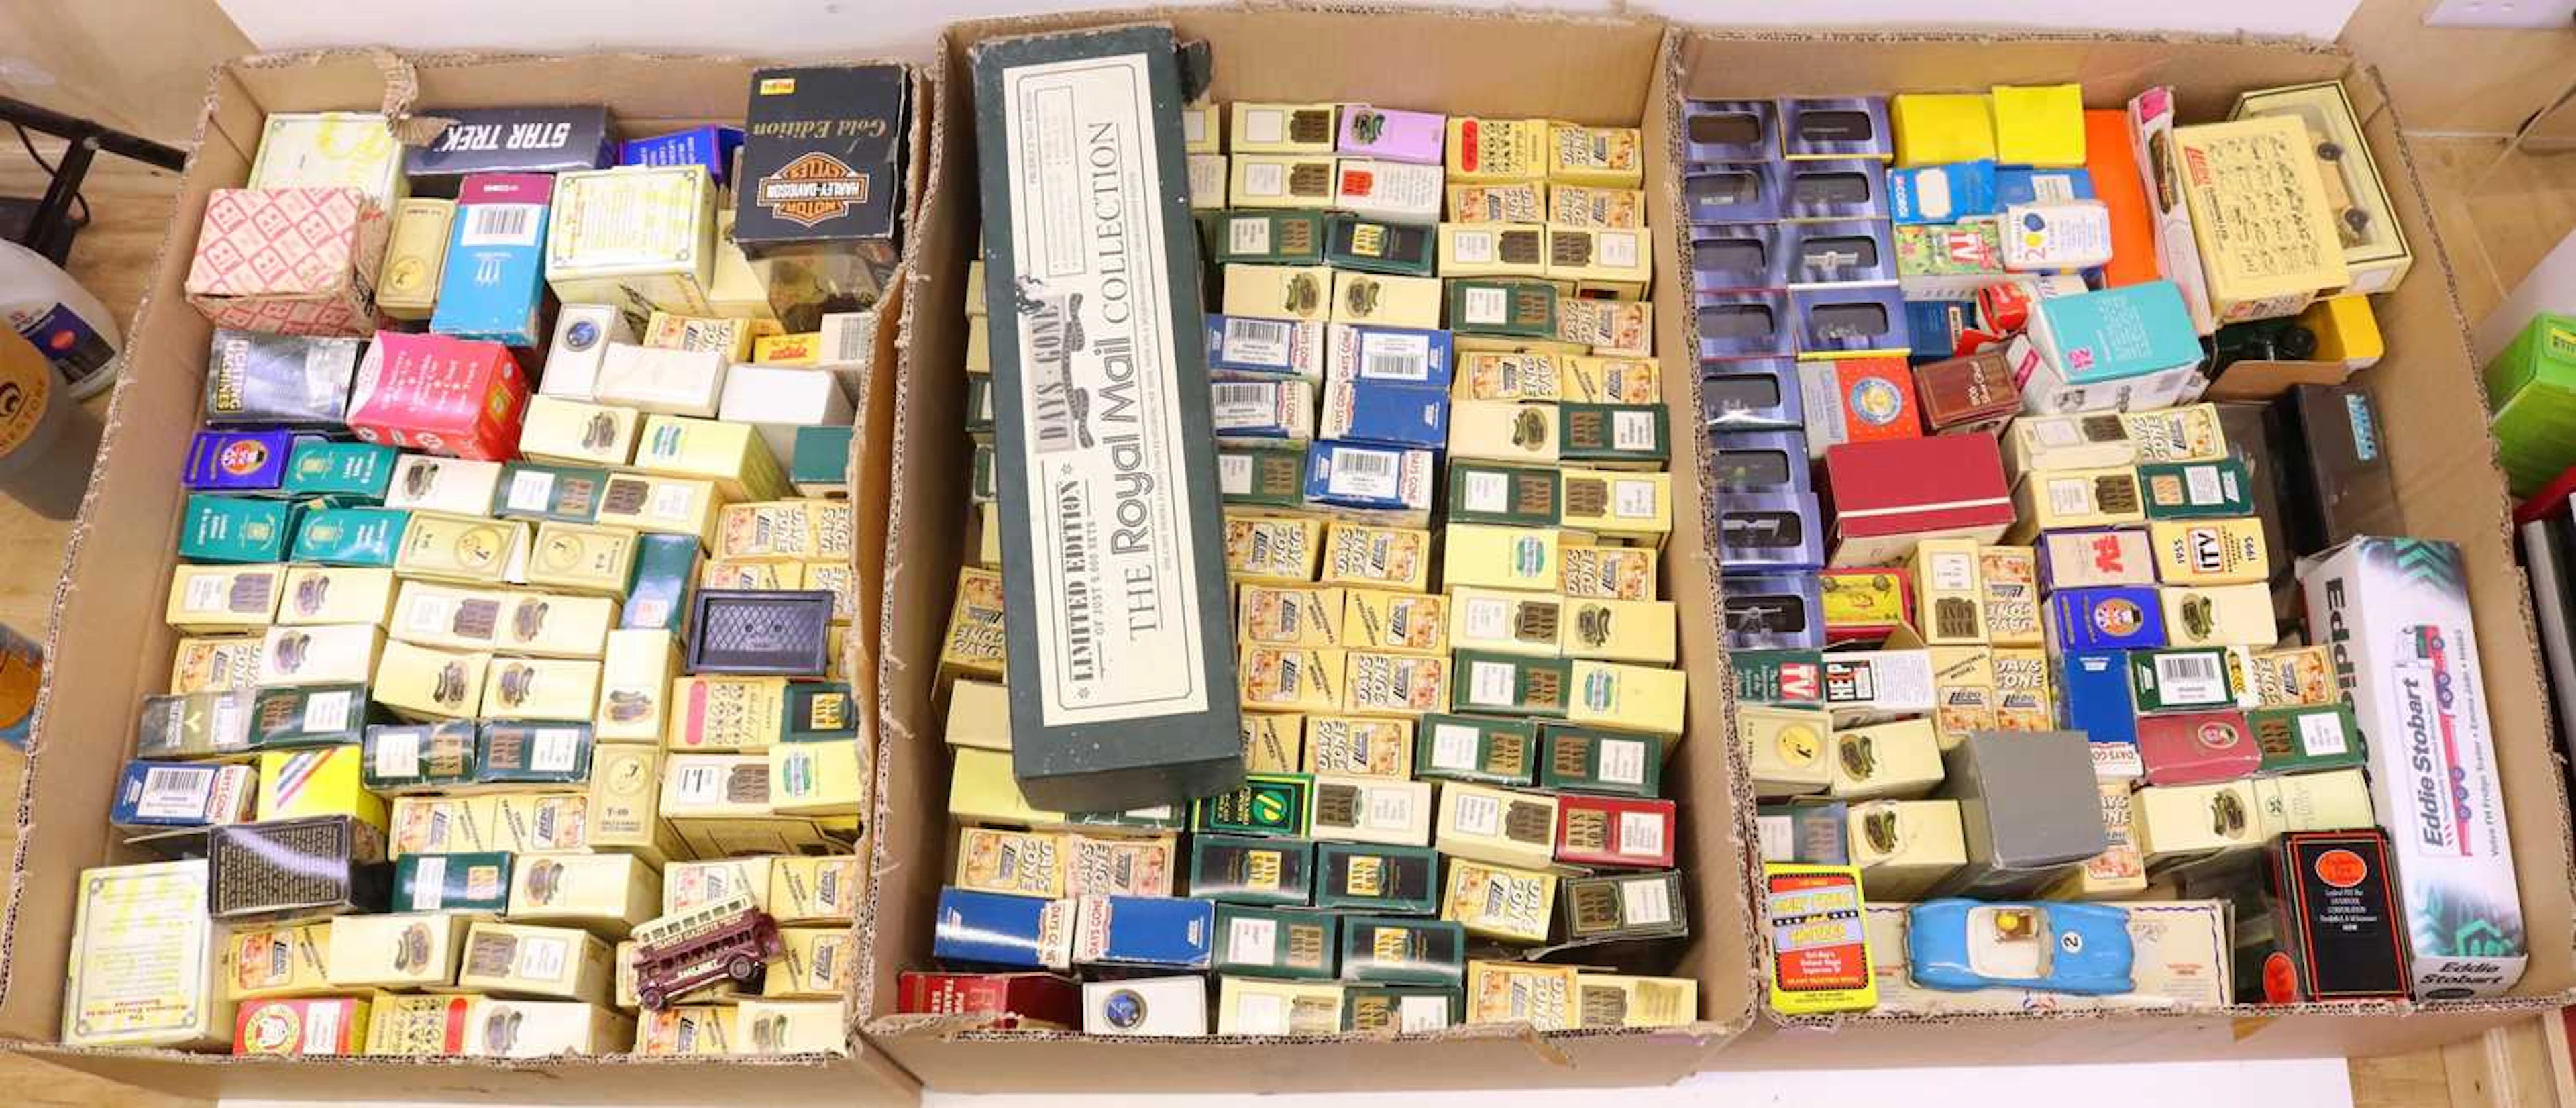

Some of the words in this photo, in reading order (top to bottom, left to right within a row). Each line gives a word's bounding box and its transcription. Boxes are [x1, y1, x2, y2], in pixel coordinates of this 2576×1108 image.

[441, 123, 500, 151] TREK
[506, 122, 571, 149] STAR
[754, 120, 833, 138] Edition
[838, 119, 888, 138] Gold
[767, 181, 860, 199] HARLEY-DAVIDSON
[783, 201, 841, 214] MOTOR
[1087, 121, 1130, 323] COLLECTION
[1094, 338, 1138, 423] Mail
[1037, 383, 1068, 440] DAYS
[1102, 434, 1155, 556] Royal
[1059, 479, 1087, 575] EDITION
[2198, 532, 2219, 569] ITV
[1125, 563, 1156, 640] THE
[1069, 581, 1094, 682] LIMITED
[1782, 665, 1807, 697] TV
[1829, 661, 1855, 699] HELP
[2402, 678, 2434, 772] Stobart
[2416, 774, 2444, 847] Eddie
[2064, 936, 2078, 946] 2
[2420, 974, 2504, 985] Stobart
[2440, 962, 2500, 974] Eddie
